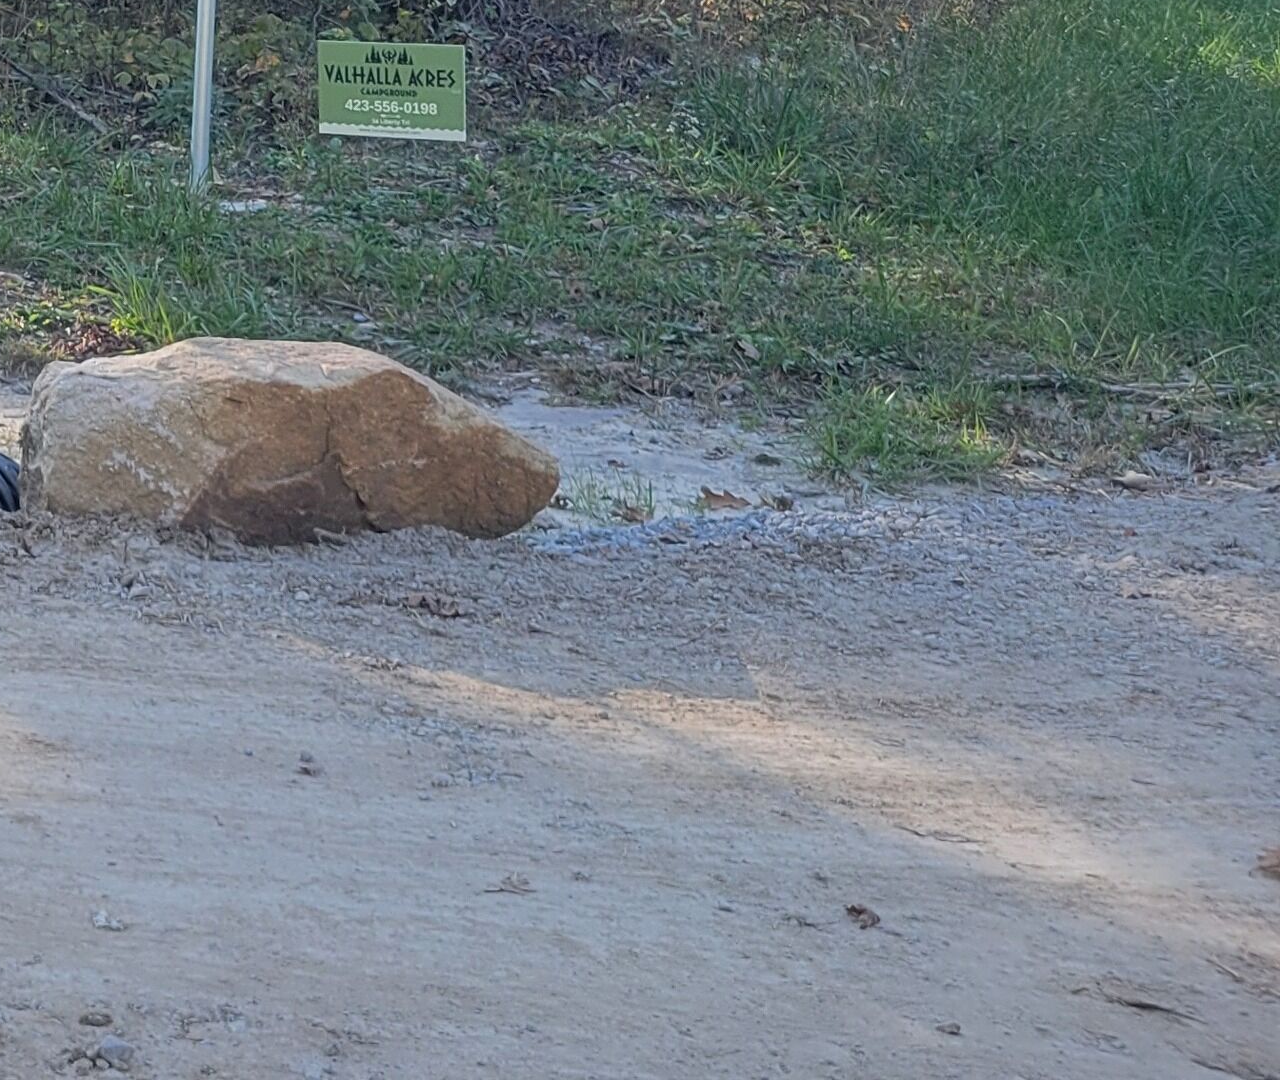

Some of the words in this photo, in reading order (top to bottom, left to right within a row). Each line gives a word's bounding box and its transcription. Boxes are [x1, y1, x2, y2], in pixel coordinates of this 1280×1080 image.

[324, 64, 402, 87] VALHALLA
[408, 69, 456, 89] ACRES
[360, 87, 418, 98] CAMPGROUND
[345, 99, 438, 115] 423-556-0198
